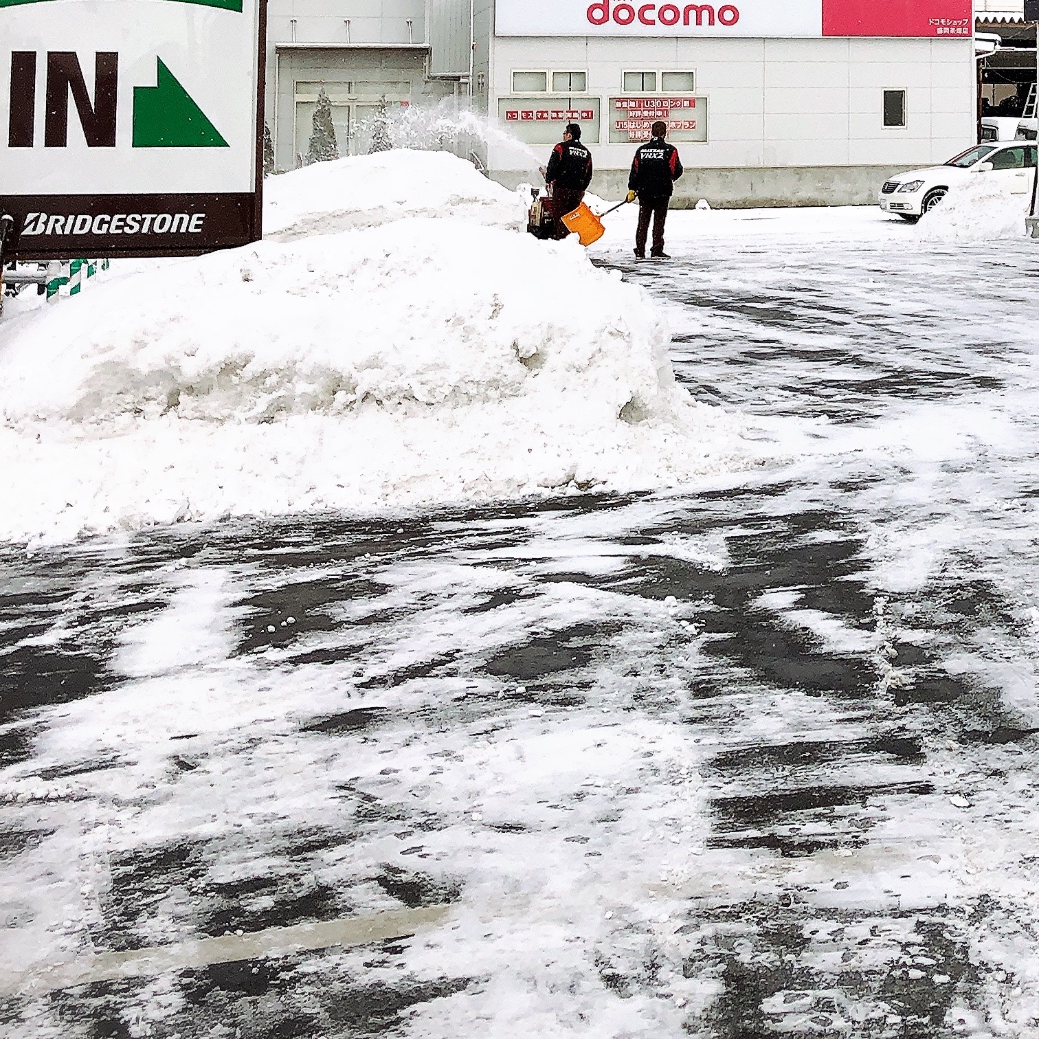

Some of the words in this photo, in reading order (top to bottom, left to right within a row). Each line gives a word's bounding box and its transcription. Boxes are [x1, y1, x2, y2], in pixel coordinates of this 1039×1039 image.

[928, 18, 969, 26] ドコモショップ
[8, 51, 119, 148] IN
[21, 212, 206, 236] BRIDGESTONE
